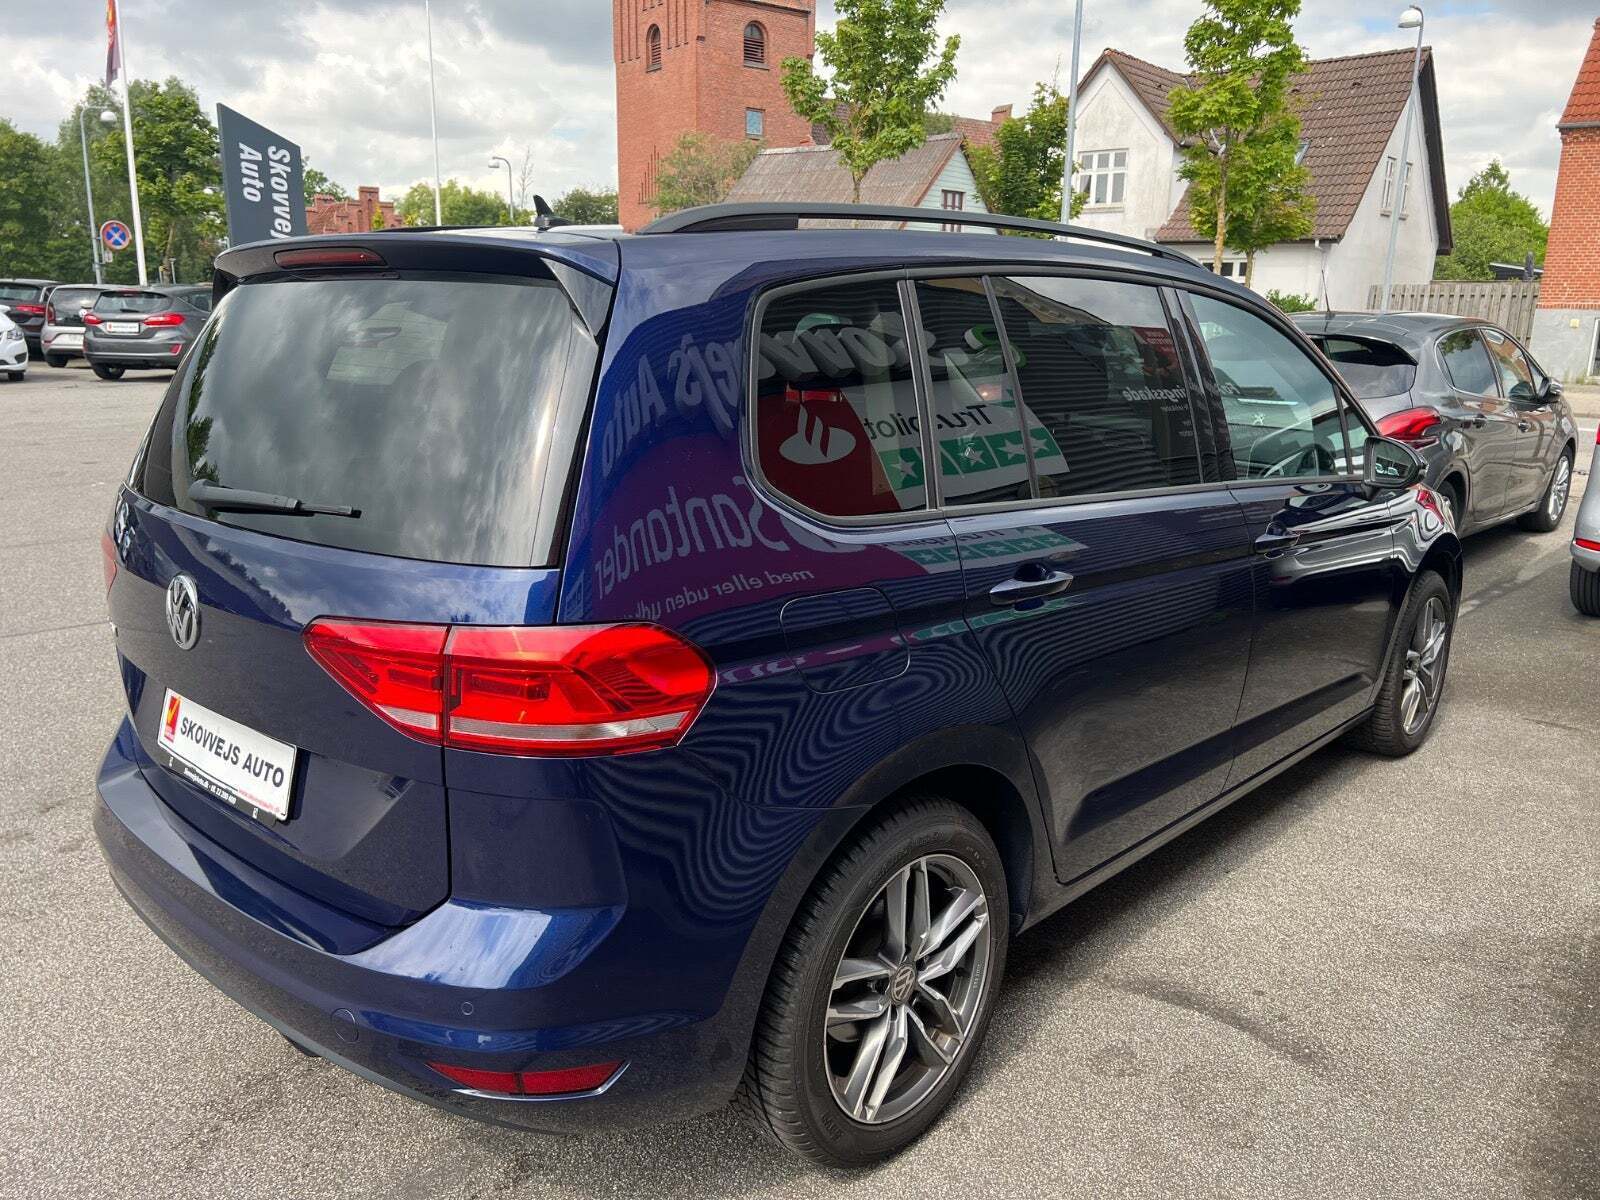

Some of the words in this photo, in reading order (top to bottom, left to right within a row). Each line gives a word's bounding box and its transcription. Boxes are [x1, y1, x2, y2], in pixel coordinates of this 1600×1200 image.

[239, 142, 264, 202] Auto
[267, 145, 292, 239] Skovvej
[180, 717, 241, 766] SKOVVEJS
[242, 753, 285, 788] AUTO
